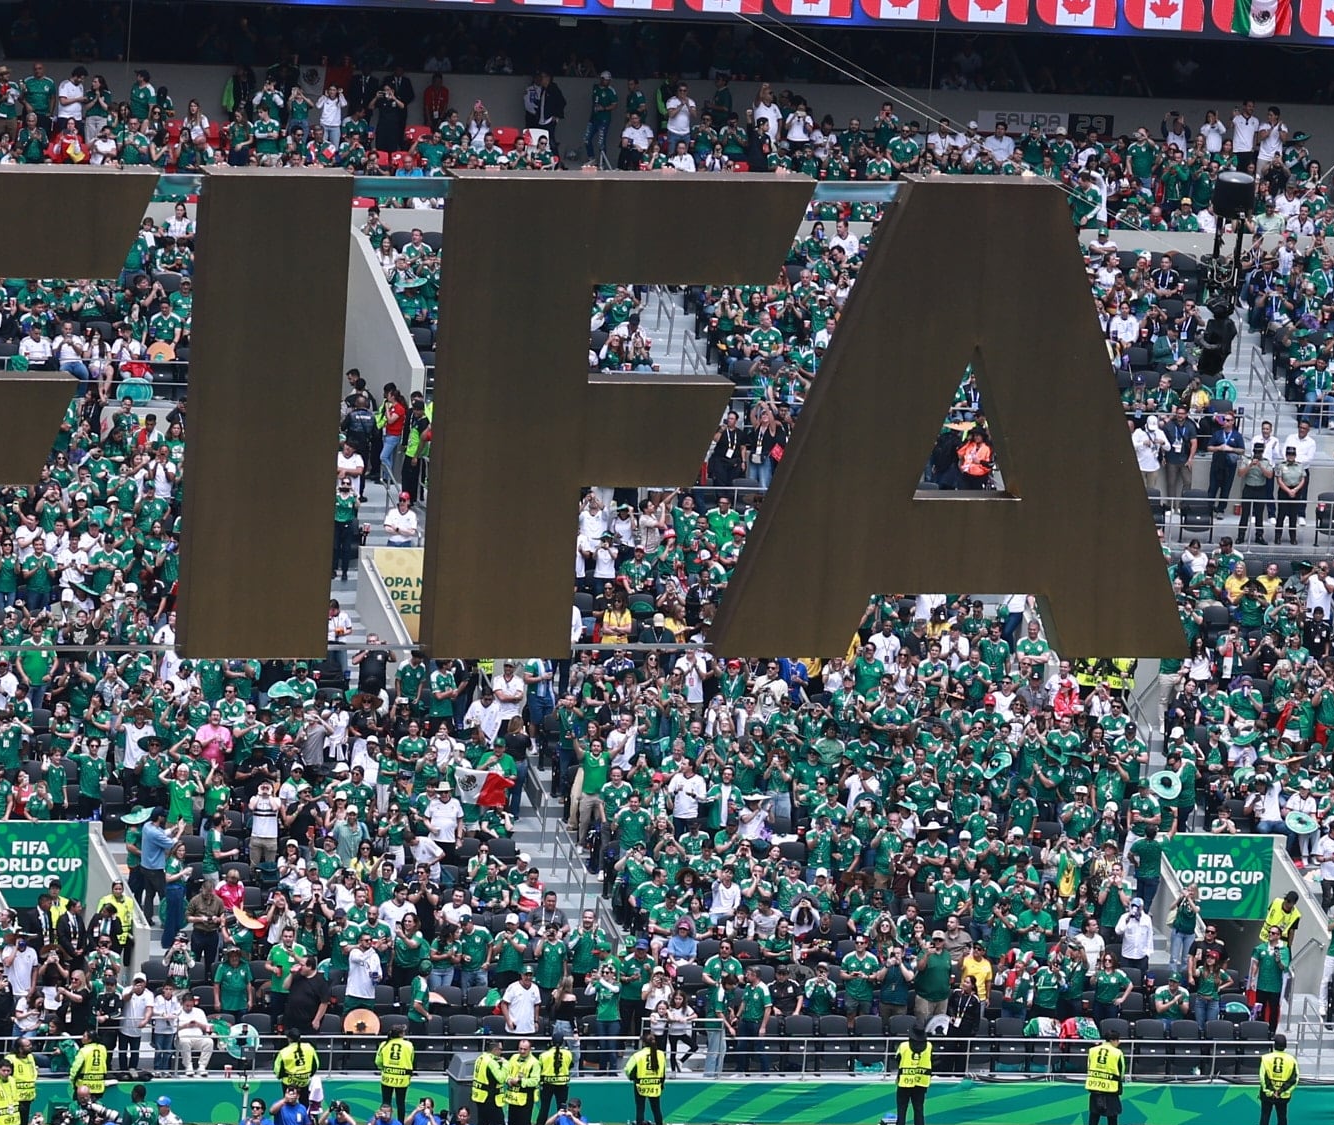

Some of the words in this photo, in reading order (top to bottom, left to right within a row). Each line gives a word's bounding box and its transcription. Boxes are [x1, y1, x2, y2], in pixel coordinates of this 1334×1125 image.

[383, 577, 413, 588] OPA
[391, 590, 409, 601] DE
[11, 840, 50, 855] FIFA
[46, 857, 82, 872] CUP
[1196, 854, 1234, 868] FIFA
[1230, 870, 1264, 885] CUP
[1199, 886, 1243, 901] 026
